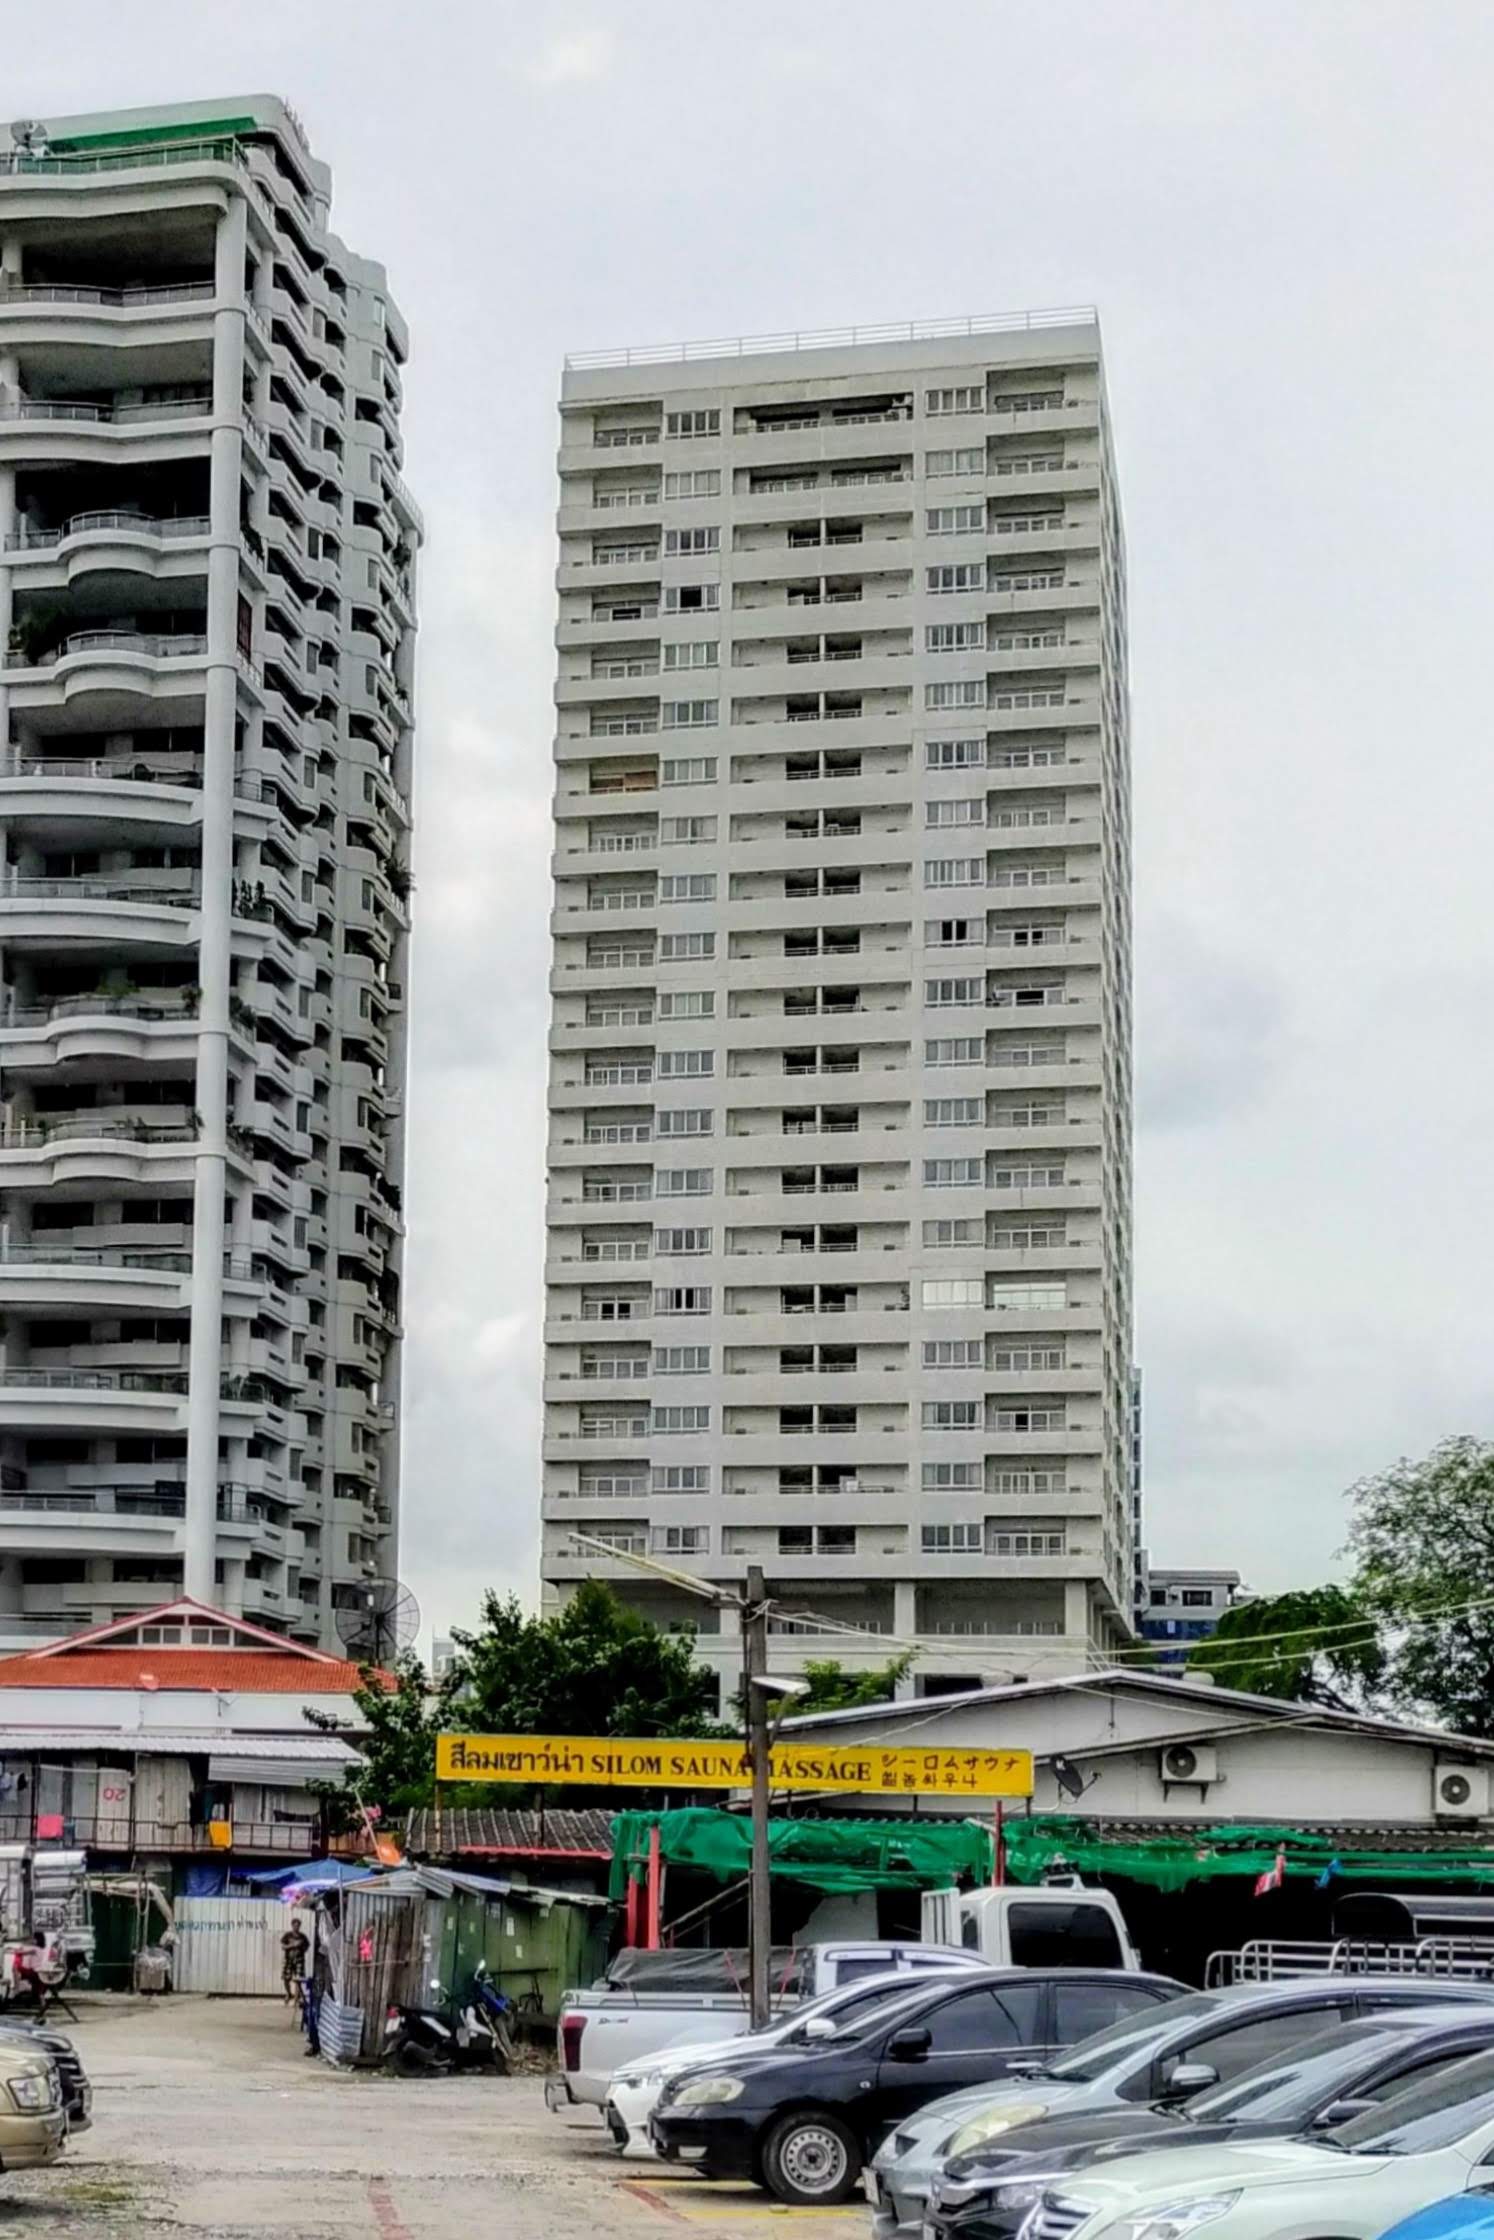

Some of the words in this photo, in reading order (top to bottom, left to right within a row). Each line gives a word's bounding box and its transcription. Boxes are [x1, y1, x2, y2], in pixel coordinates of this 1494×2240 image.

[591, 1755, 662, 1775] SILOM
[670, 1756, 747, 1778] SAUNA
[881, 1753, 1020, 1771] シーロムサウナ
